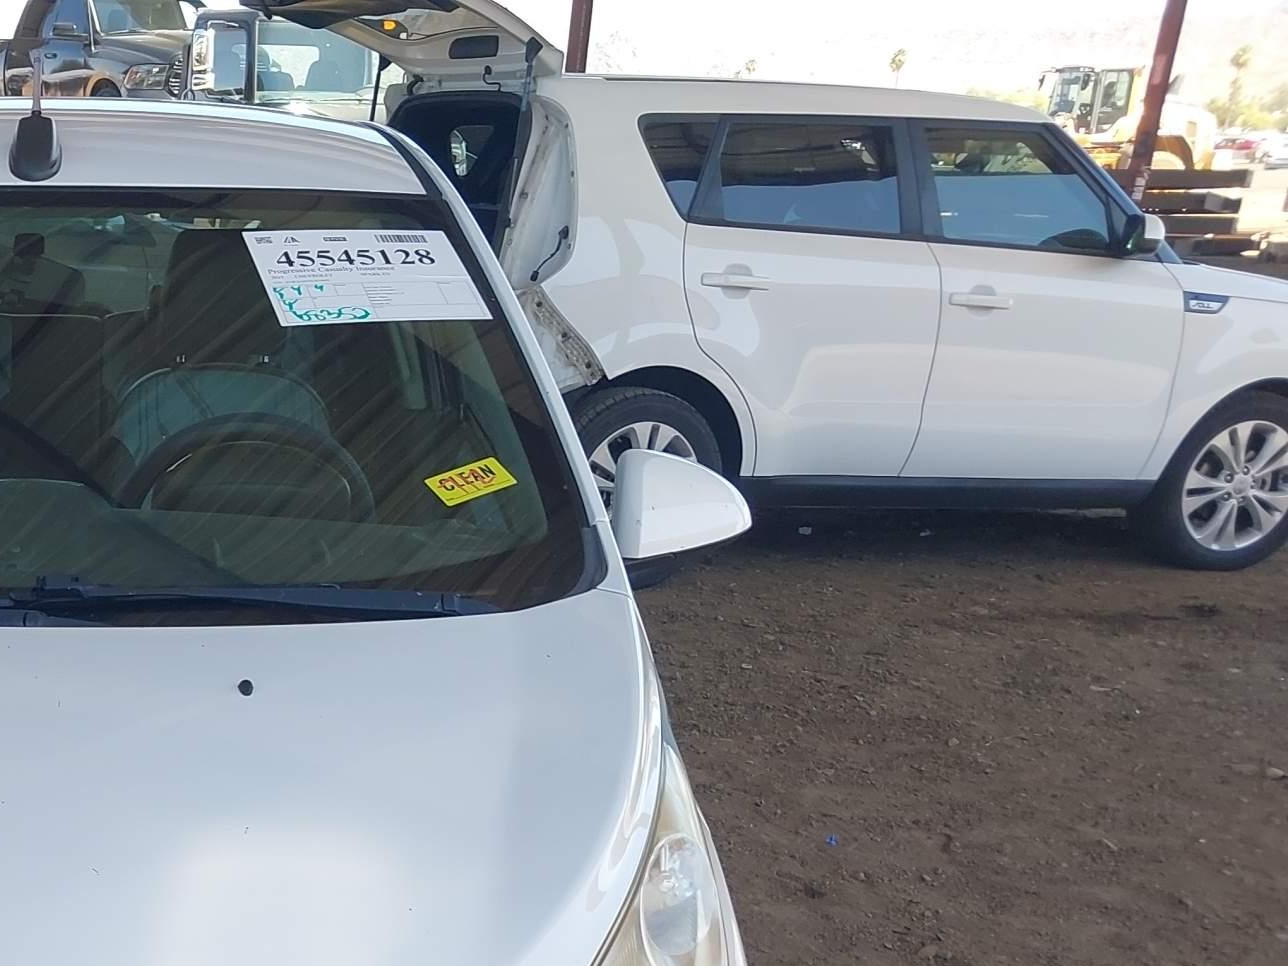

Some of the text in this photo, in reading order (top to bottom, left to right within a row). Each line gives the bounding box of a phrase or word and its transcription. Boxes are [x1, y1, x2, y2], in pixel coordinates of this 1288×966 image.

[276, 249, 436, 267] 45545128
[267, 267, 317, 275] Progressive
[438, 464, 497, 491] CLEAN
